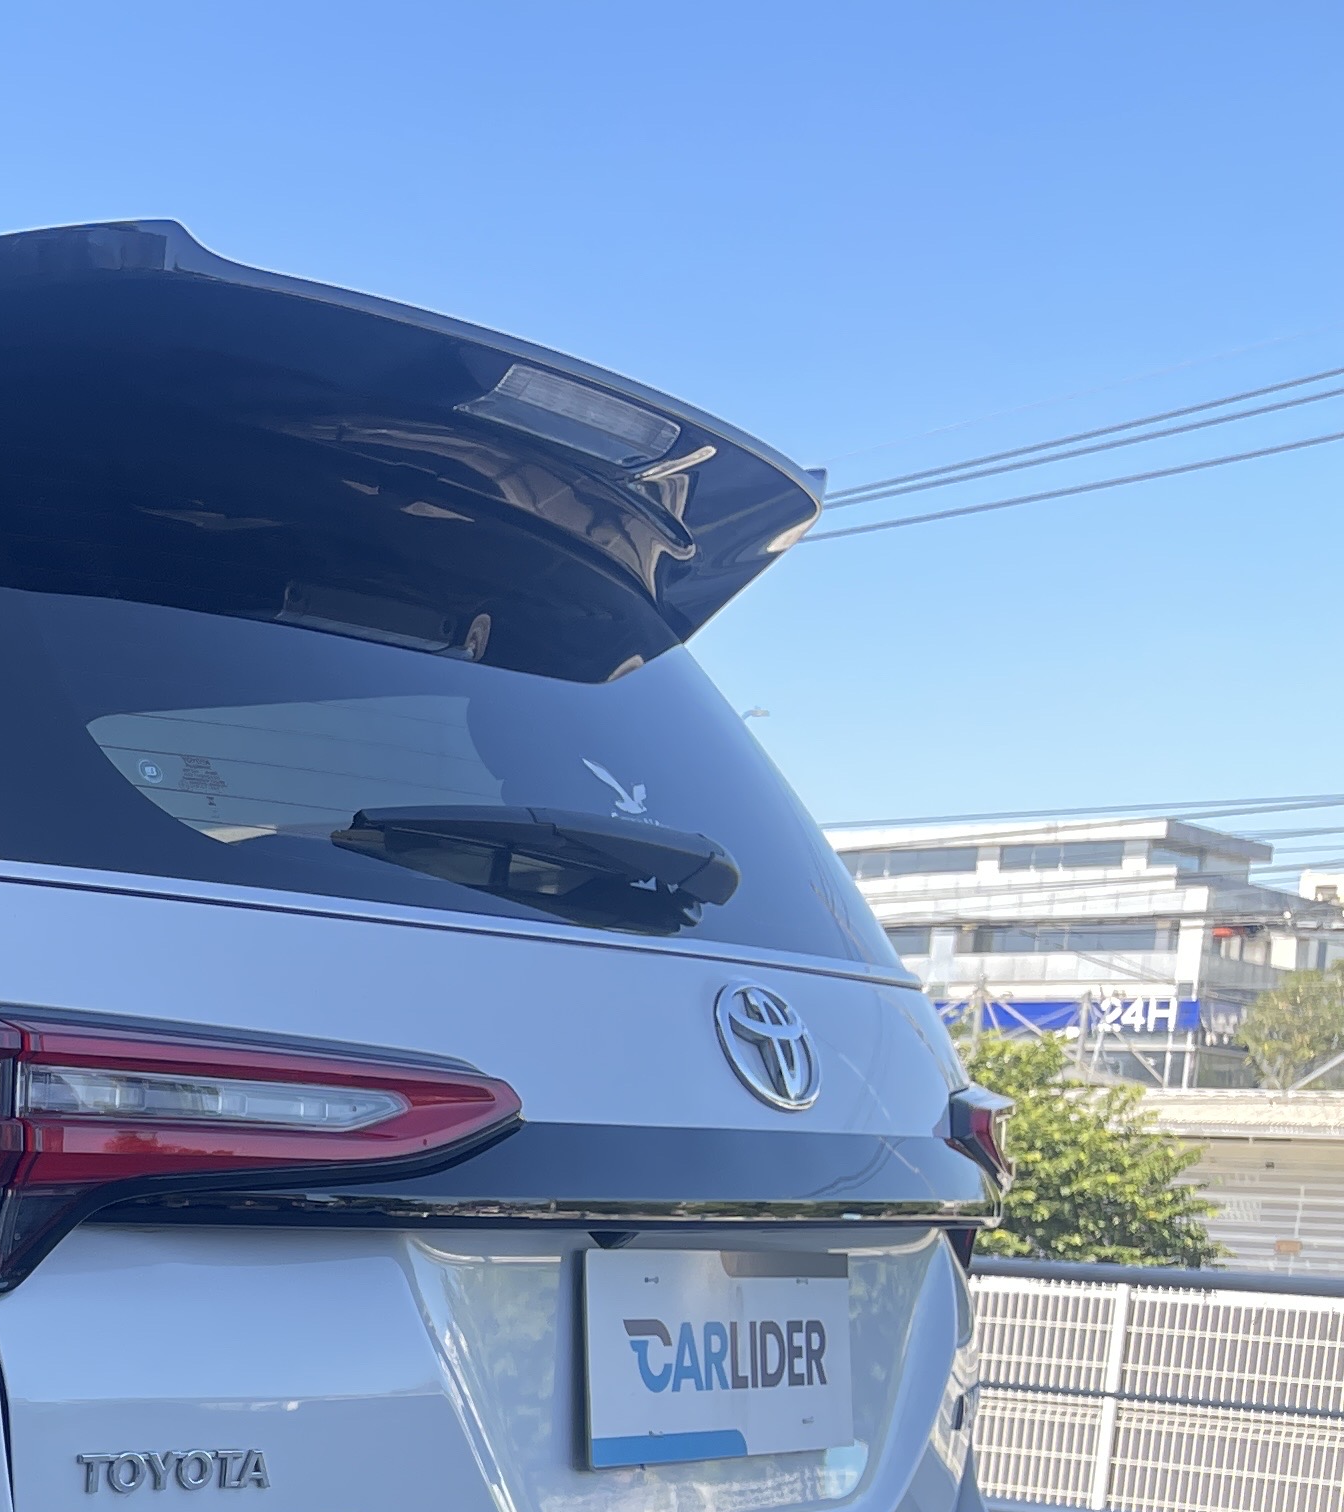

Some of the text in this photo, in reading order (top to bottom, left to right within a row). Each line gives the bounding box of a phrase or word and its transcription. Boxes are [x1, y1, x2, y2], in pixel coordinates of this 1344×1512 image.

[1098, 997, 1177, 1032] 24H
[622, 1319, 827, 1393] CARLIDER
[77, 1448, 271, 1494] TOYOTA
